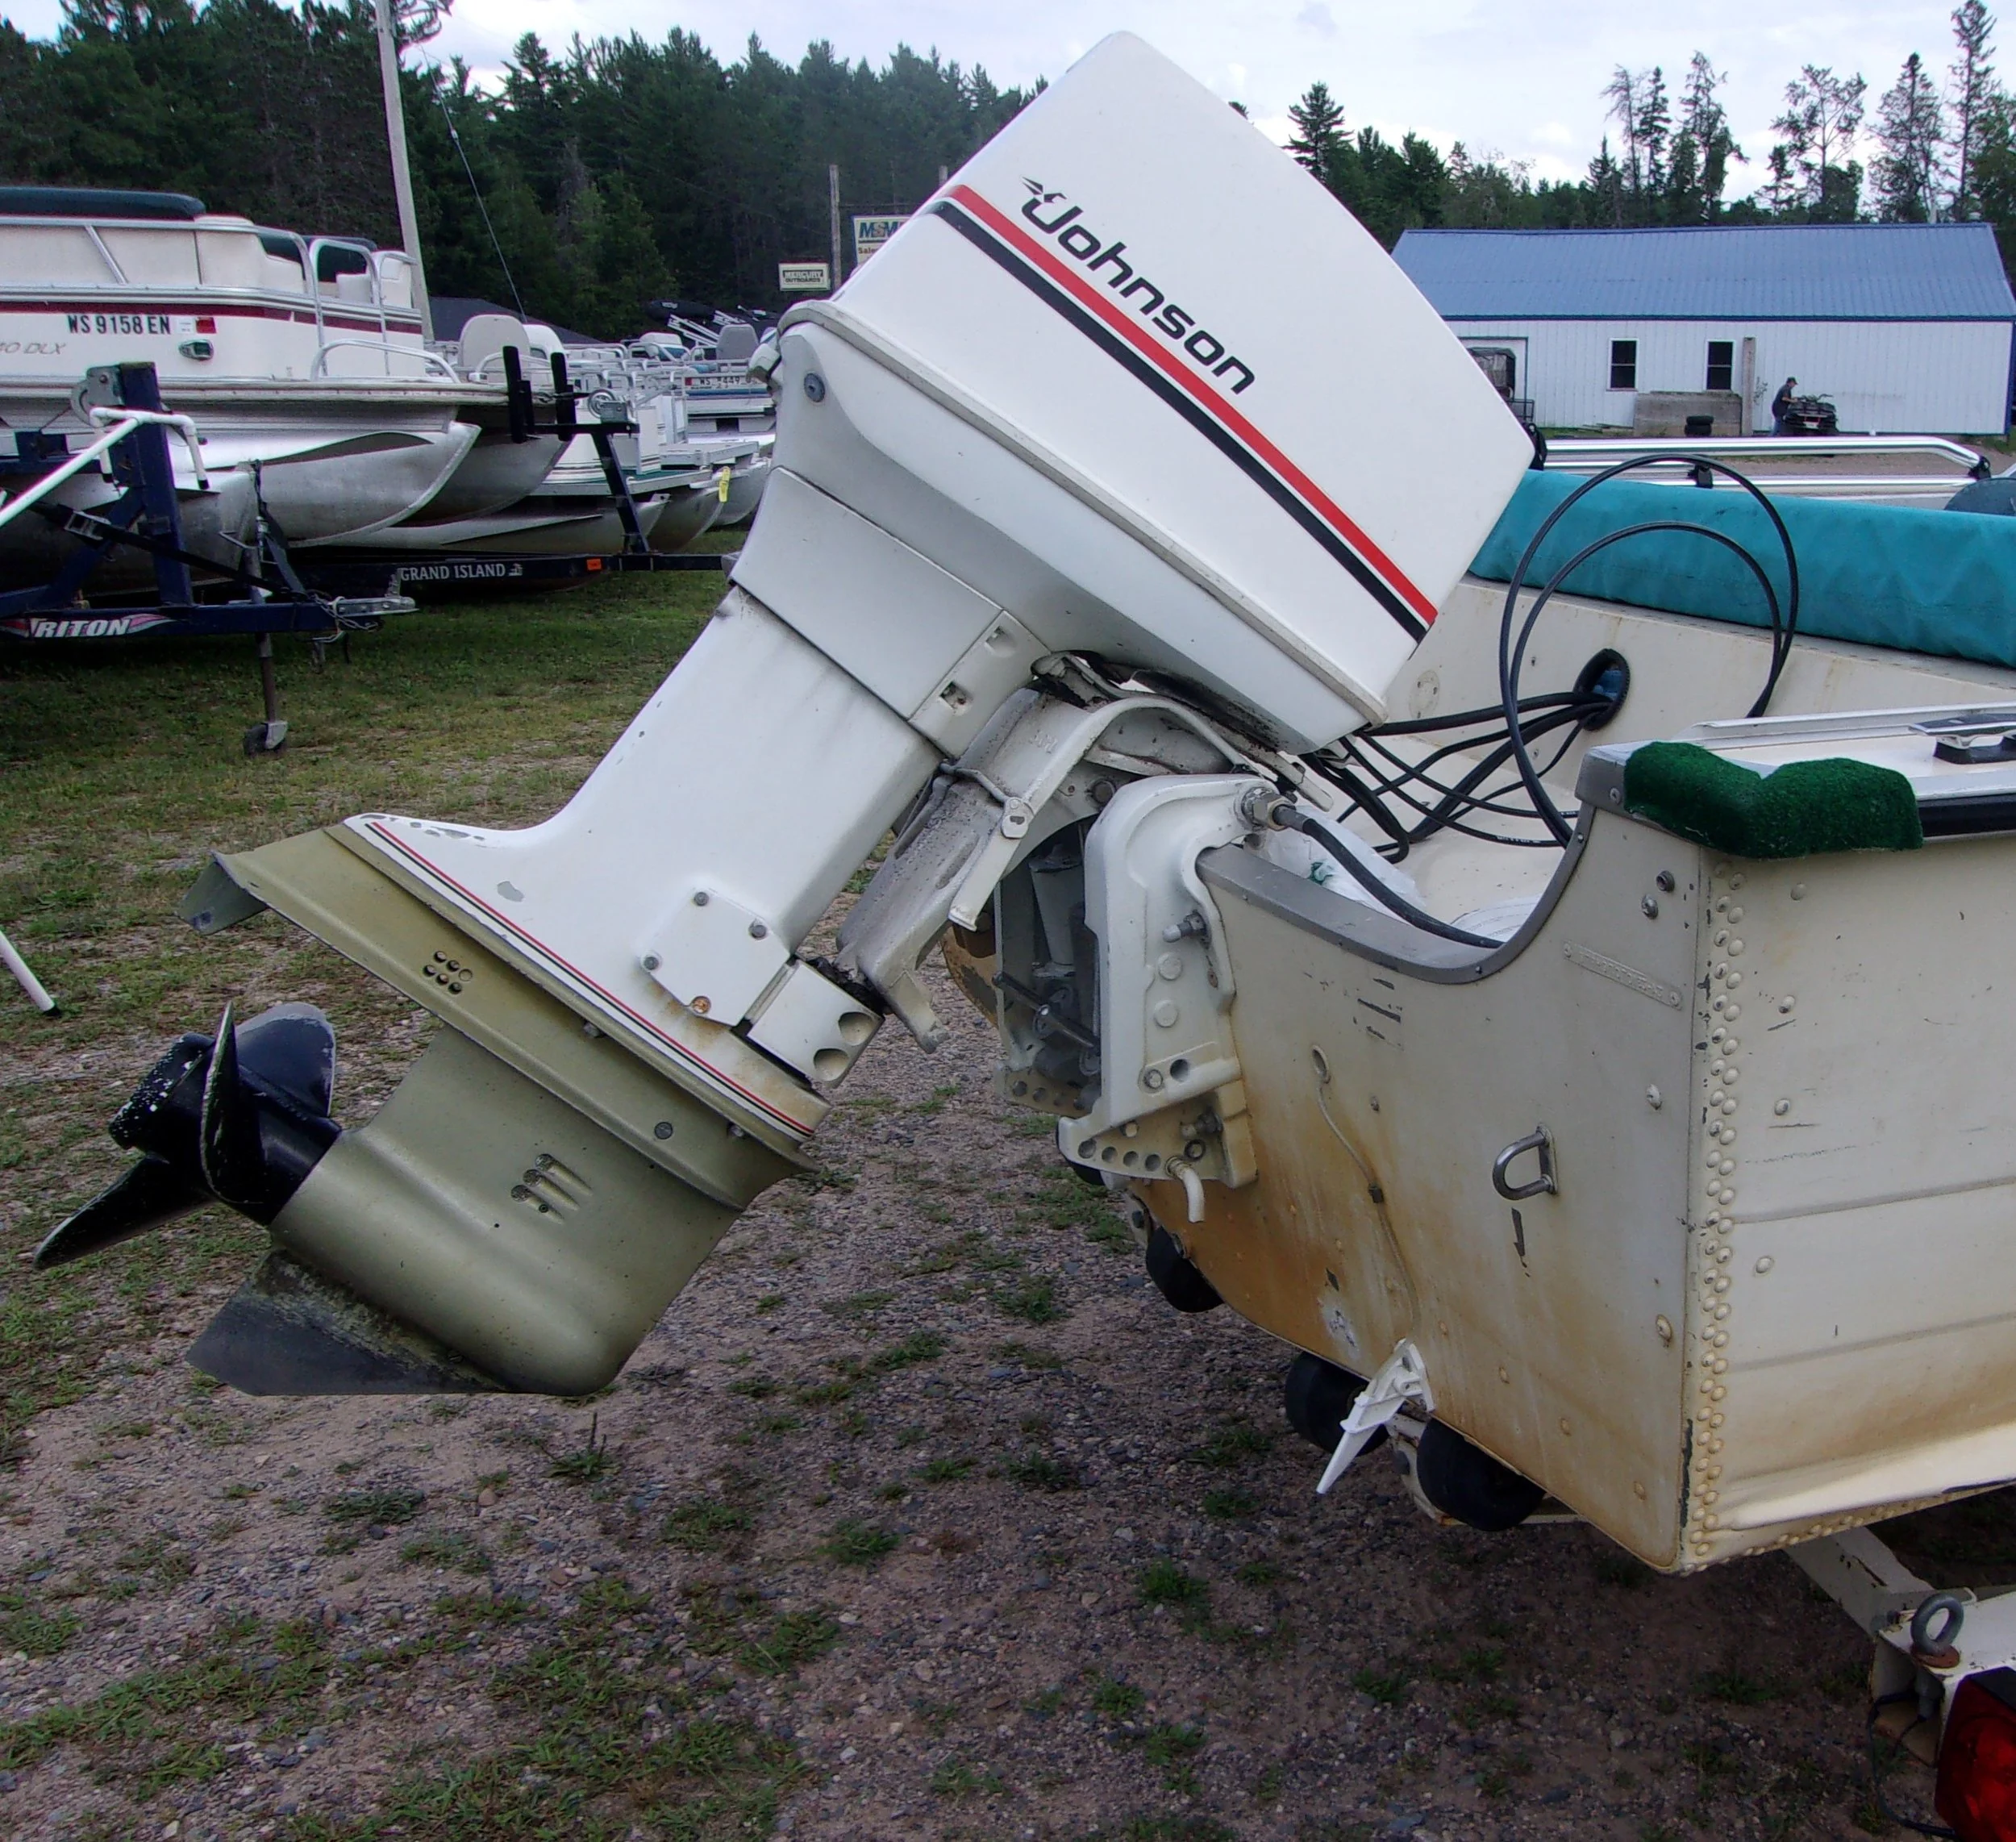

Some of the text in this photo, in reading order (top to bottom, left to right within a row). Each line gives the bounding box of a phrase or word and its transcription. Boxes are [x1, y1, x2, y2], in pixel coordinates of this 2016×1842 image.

[784, 270, 822, 279] MERCURY
[1019, 192, 1256, 395] Johnson
[67, 314, 91, 334] WS
[95, 315, 144, 335] 9158
[148, 315, 172, 335] EN
[23, 342, 67, 355] DLX
[401, 563, 506, 581] GRAND ISLAND
[30, 618, 131, 638] TRITON
